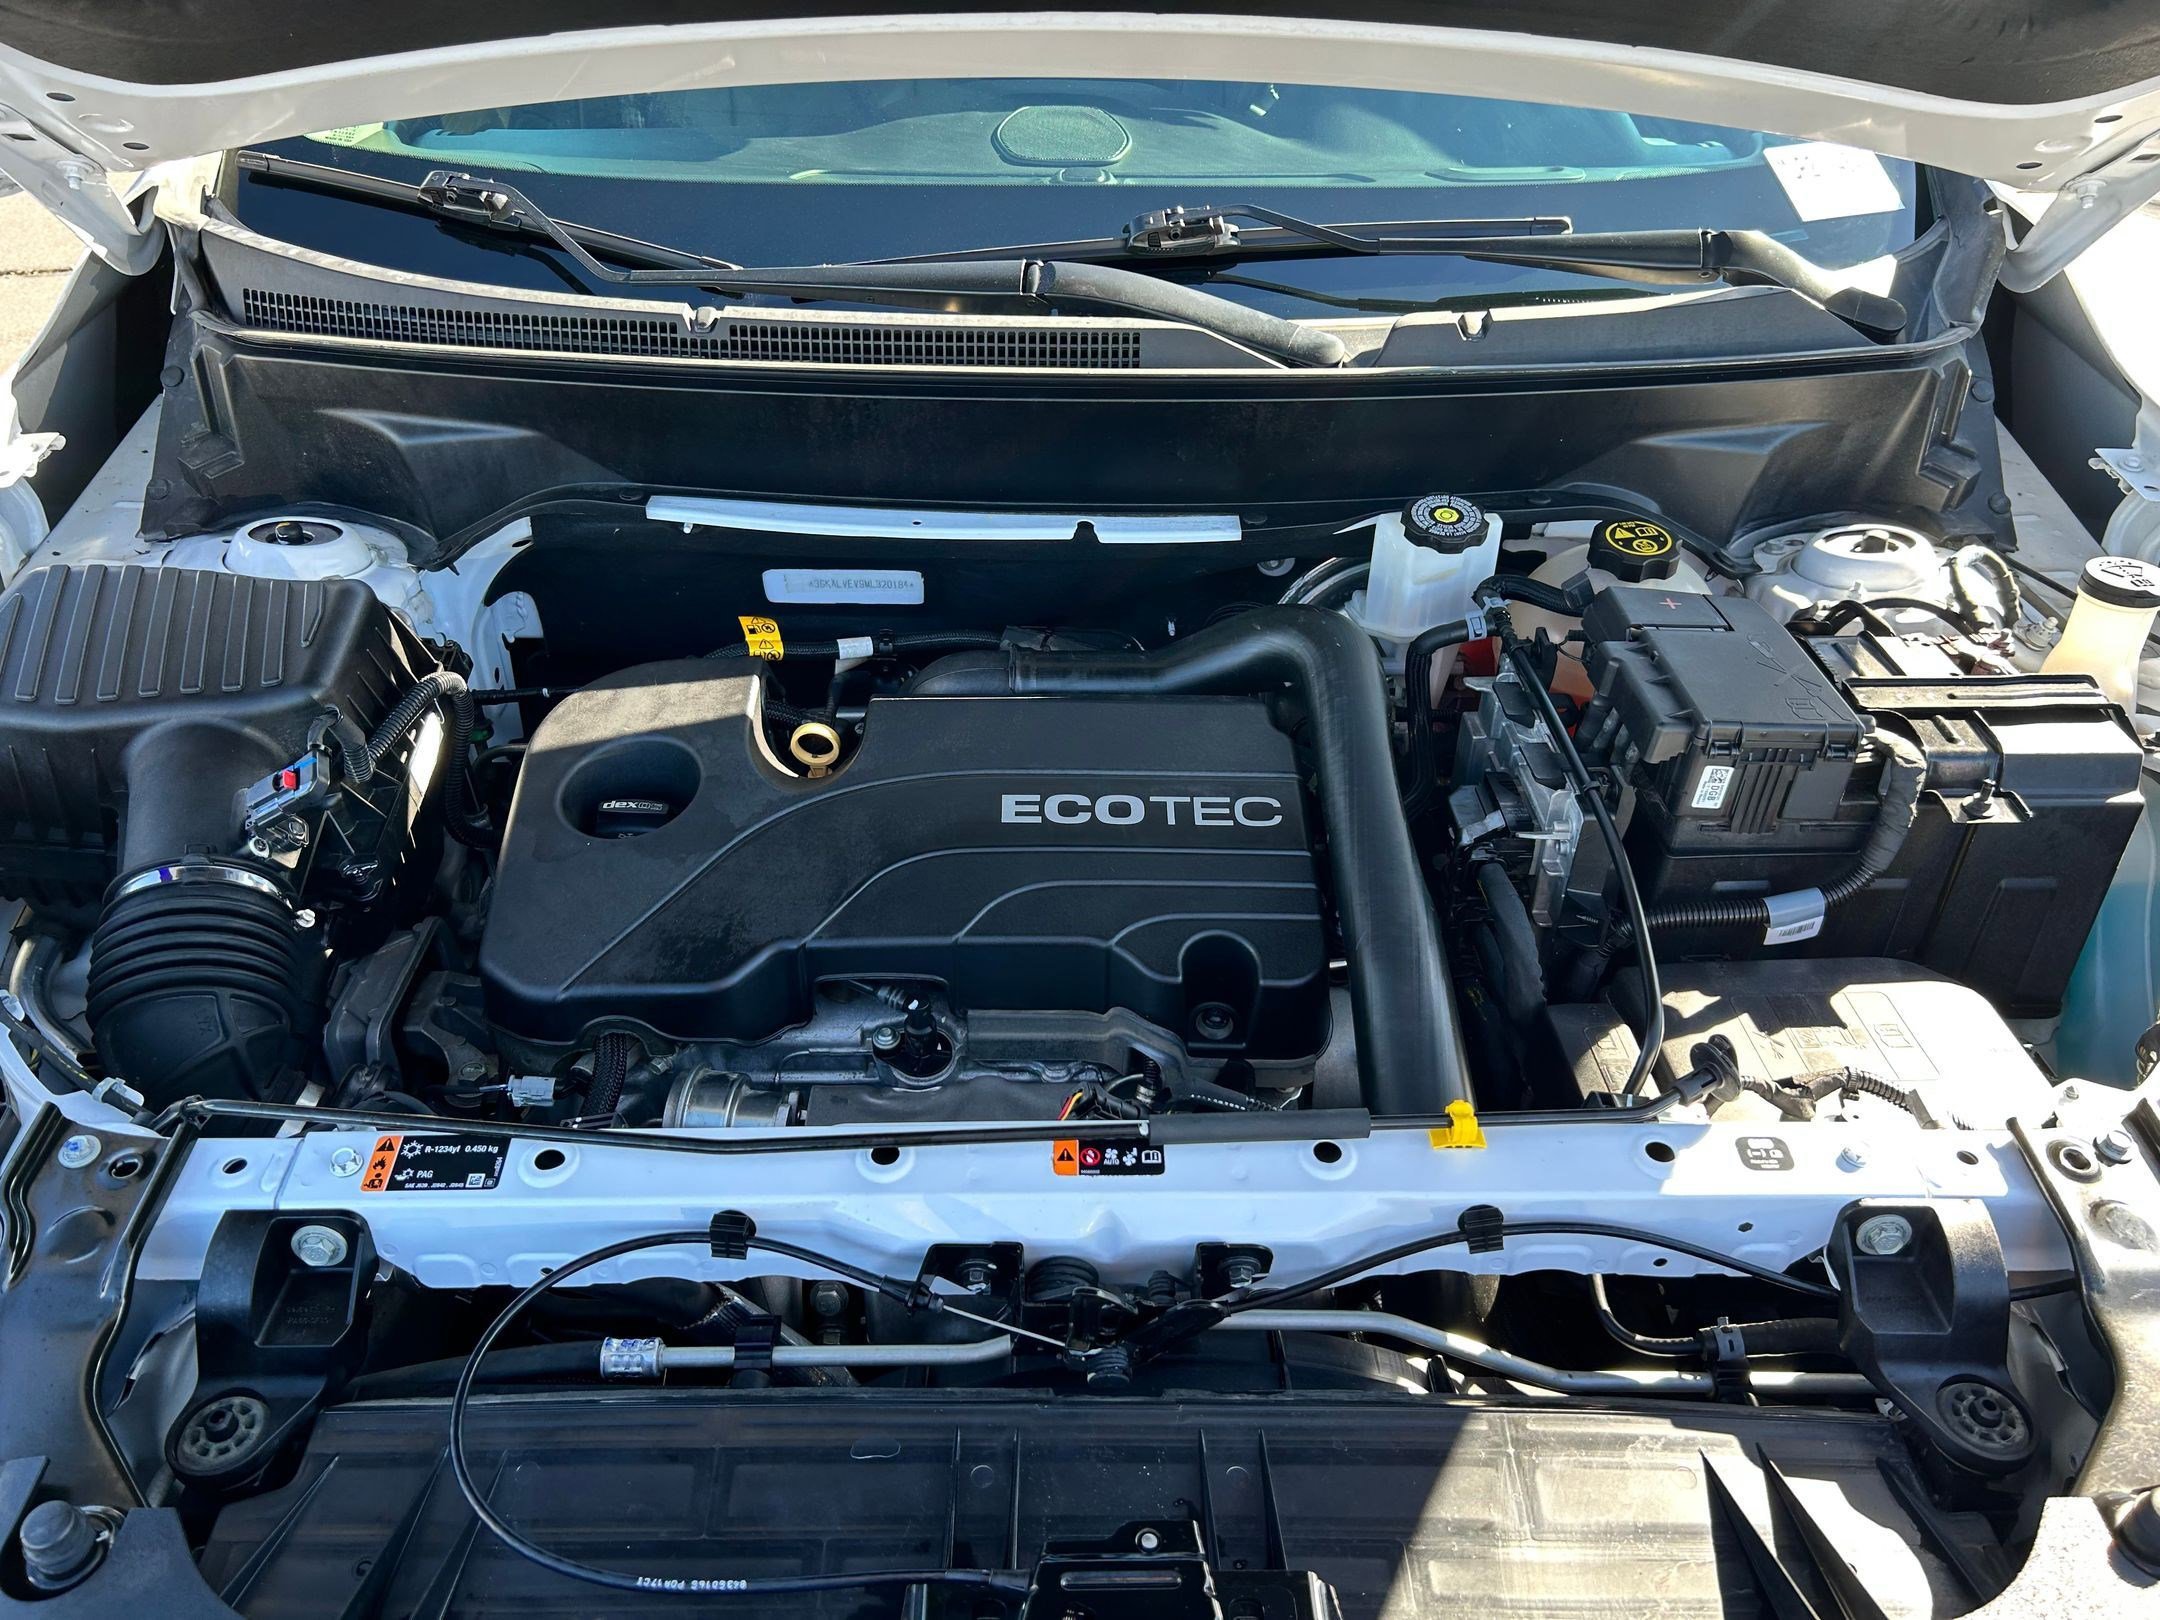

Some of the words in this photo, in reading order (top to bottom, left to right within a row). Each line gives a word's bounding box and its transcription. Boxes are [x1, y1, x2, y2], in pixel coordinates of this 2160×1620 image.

[1707, 785, 1720, 801] DGB
[602, 800, 663, 811] dexos
[1001, 794, 1283, 827] ECOTEC
[424, 1144, 461, 1153] R-1234yf
[464, 1145, 487, 1153] 0.450
[487, 1145, 499, 1154] kg
[416, 1170, 434, 1178] PAG
